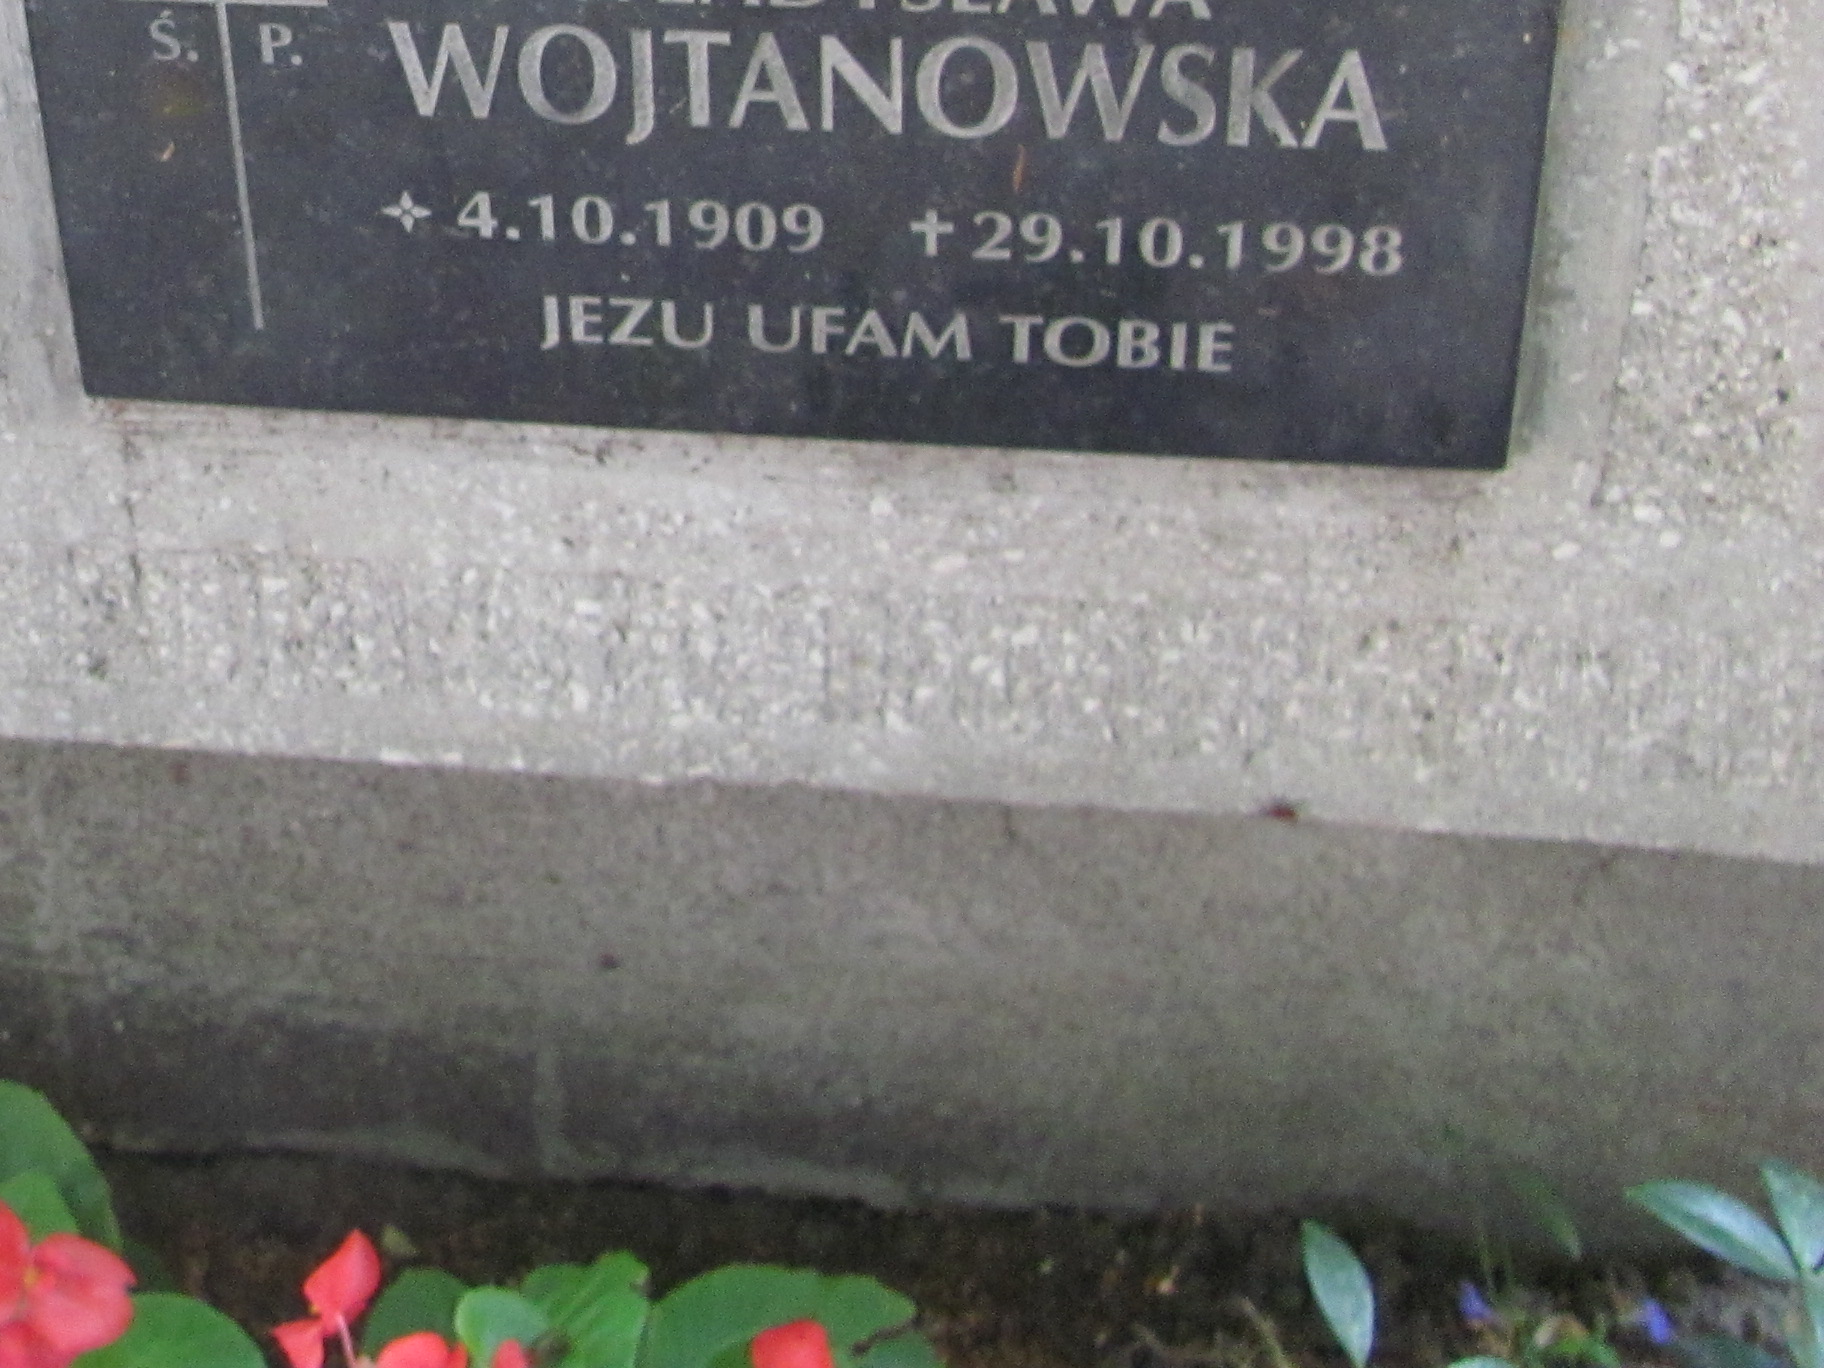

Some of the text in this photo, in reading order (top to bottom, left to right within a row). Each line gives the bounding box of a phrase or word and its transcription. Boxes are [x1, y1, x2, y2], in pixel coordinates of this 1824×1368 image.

[387, 20, 1388, 151] WOJTANOWSKA
[456, 190, 1404, 277] 4.10.1909 29.10.1998
[541, 294, 1237, 374] JEZU UFAM TOBIE
